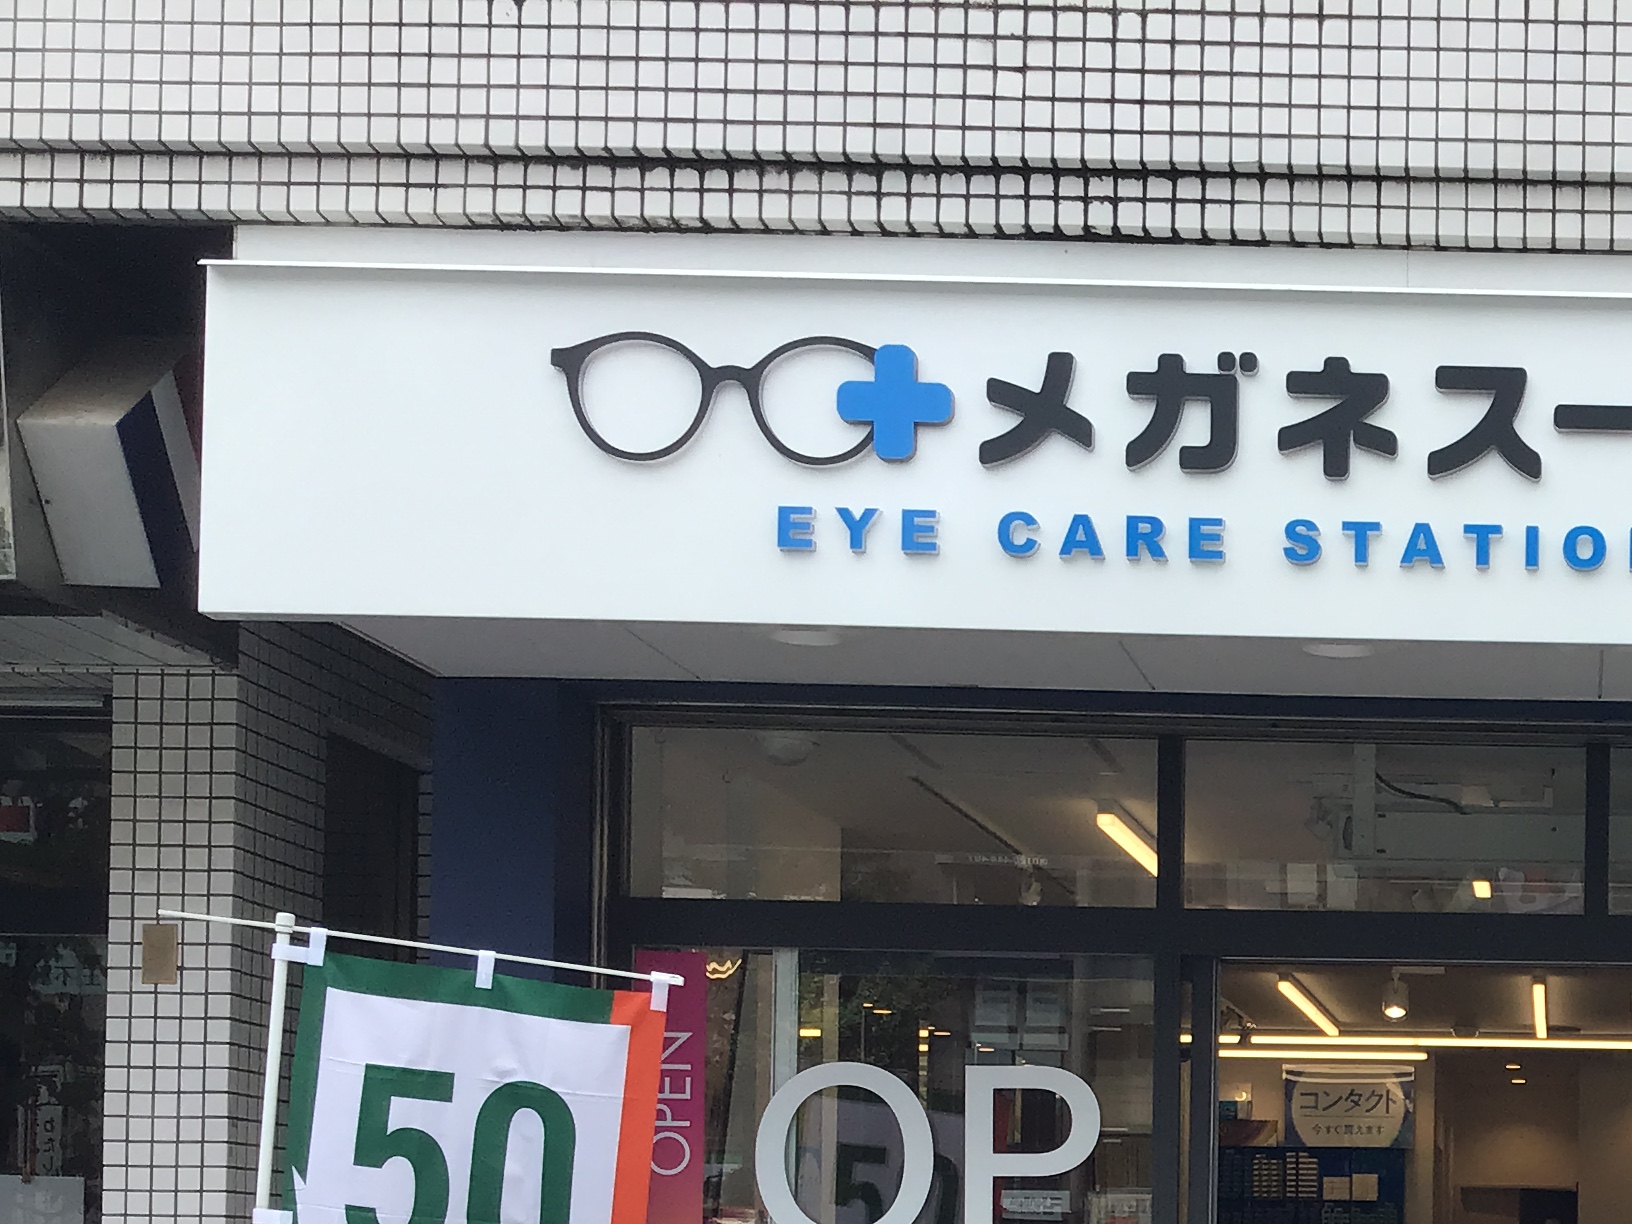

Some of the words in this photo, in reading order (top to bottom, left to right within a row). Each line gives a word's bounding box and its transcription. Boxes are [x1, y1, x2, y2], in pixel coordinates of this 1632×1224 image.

[777, 505, 941, 556] EYE
[999, 511, 1227, 565] CARE
[650, 1031, 692, 1176] OPEN
[1300, 1088, 1397, 1114] コンタクト
